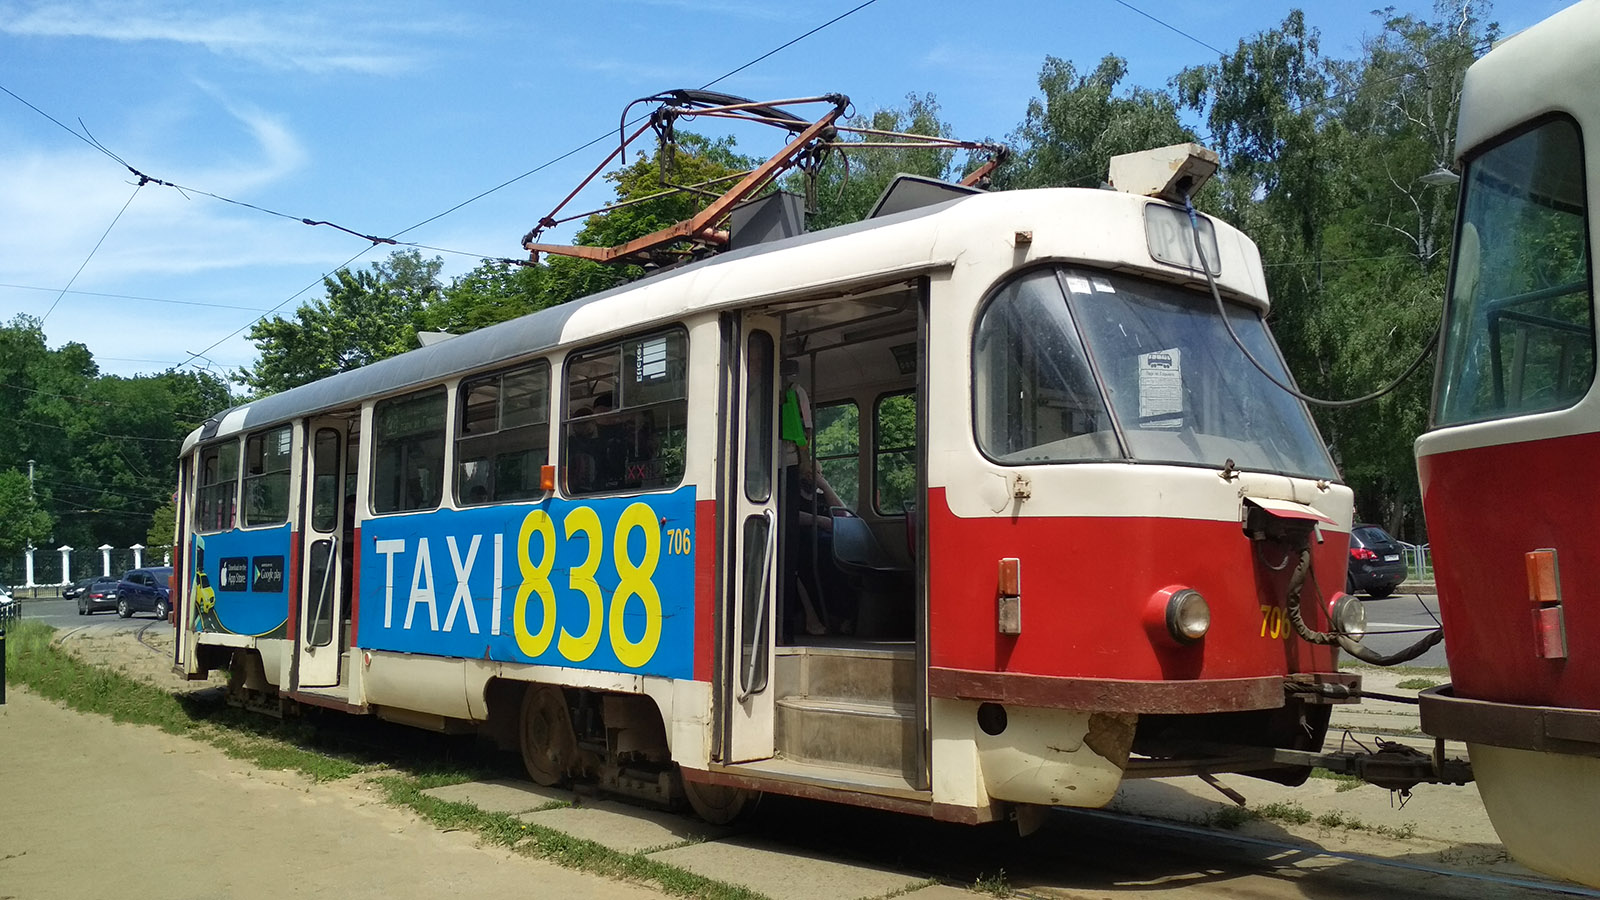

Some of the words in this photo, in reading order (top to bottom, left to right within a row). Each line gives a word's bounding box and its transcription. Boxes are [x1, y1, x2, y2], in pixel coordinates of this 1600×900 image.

[667, 529, 691, 555] 706
[228, 573, 236, 585] App
[236, 573, 246, 583] Store
[261, 569, 273, 582] Google
[273, 570, 281, 581] play
[375, 533, 503, 635] TAXI
[513, 502, 662, 667] 838
[1260, 605, 1290, 639] 706
